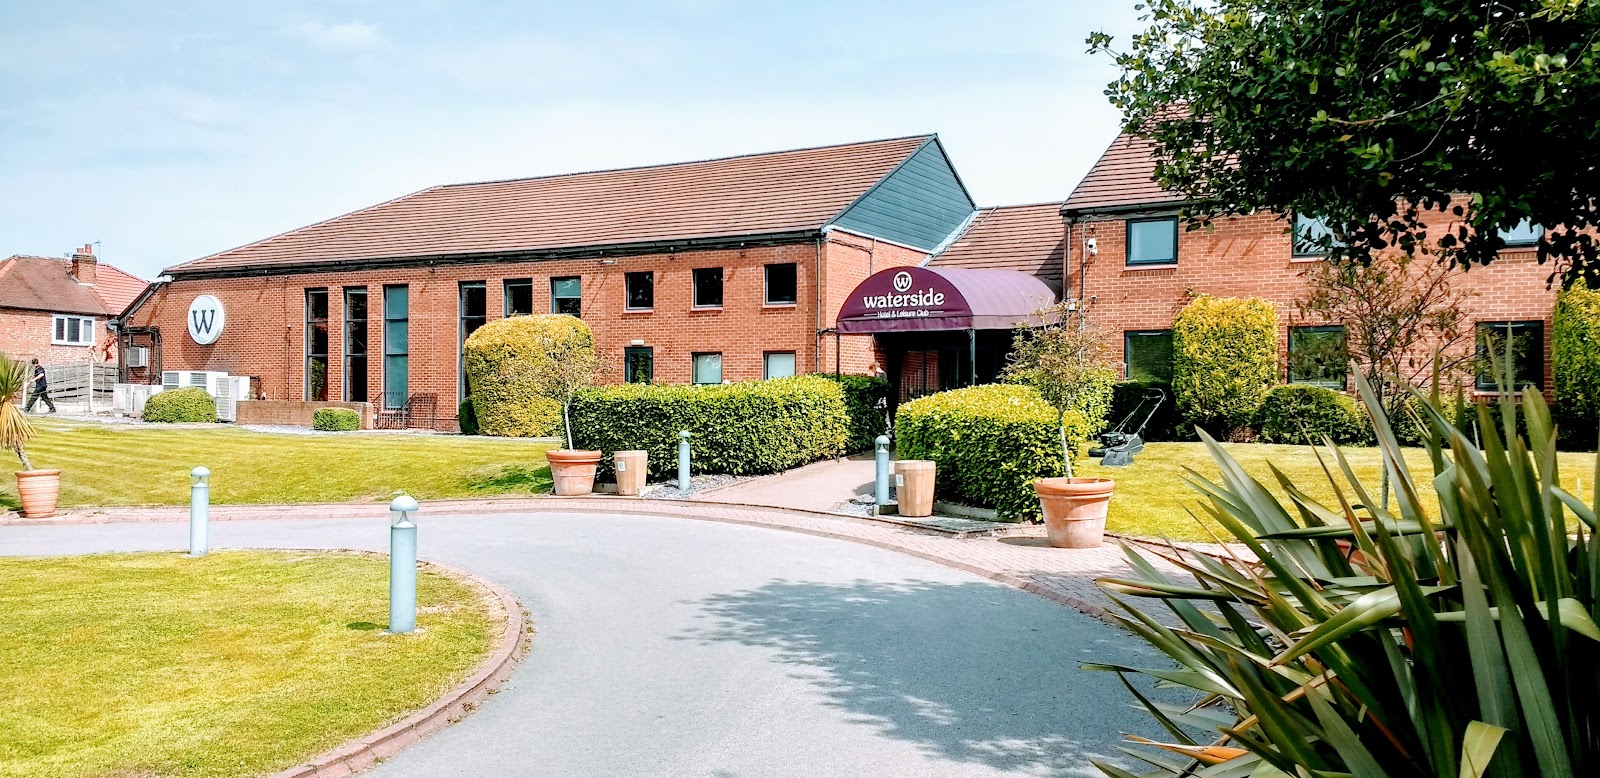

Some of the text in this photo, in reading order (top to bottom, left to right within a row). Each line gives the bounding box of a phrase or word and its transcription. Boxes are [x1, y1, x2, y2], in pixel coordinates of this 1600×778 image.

[863, 288, 945, 308] waterside
[192, 309, 215, 334] W
[916, 309, 929, 317] Club
